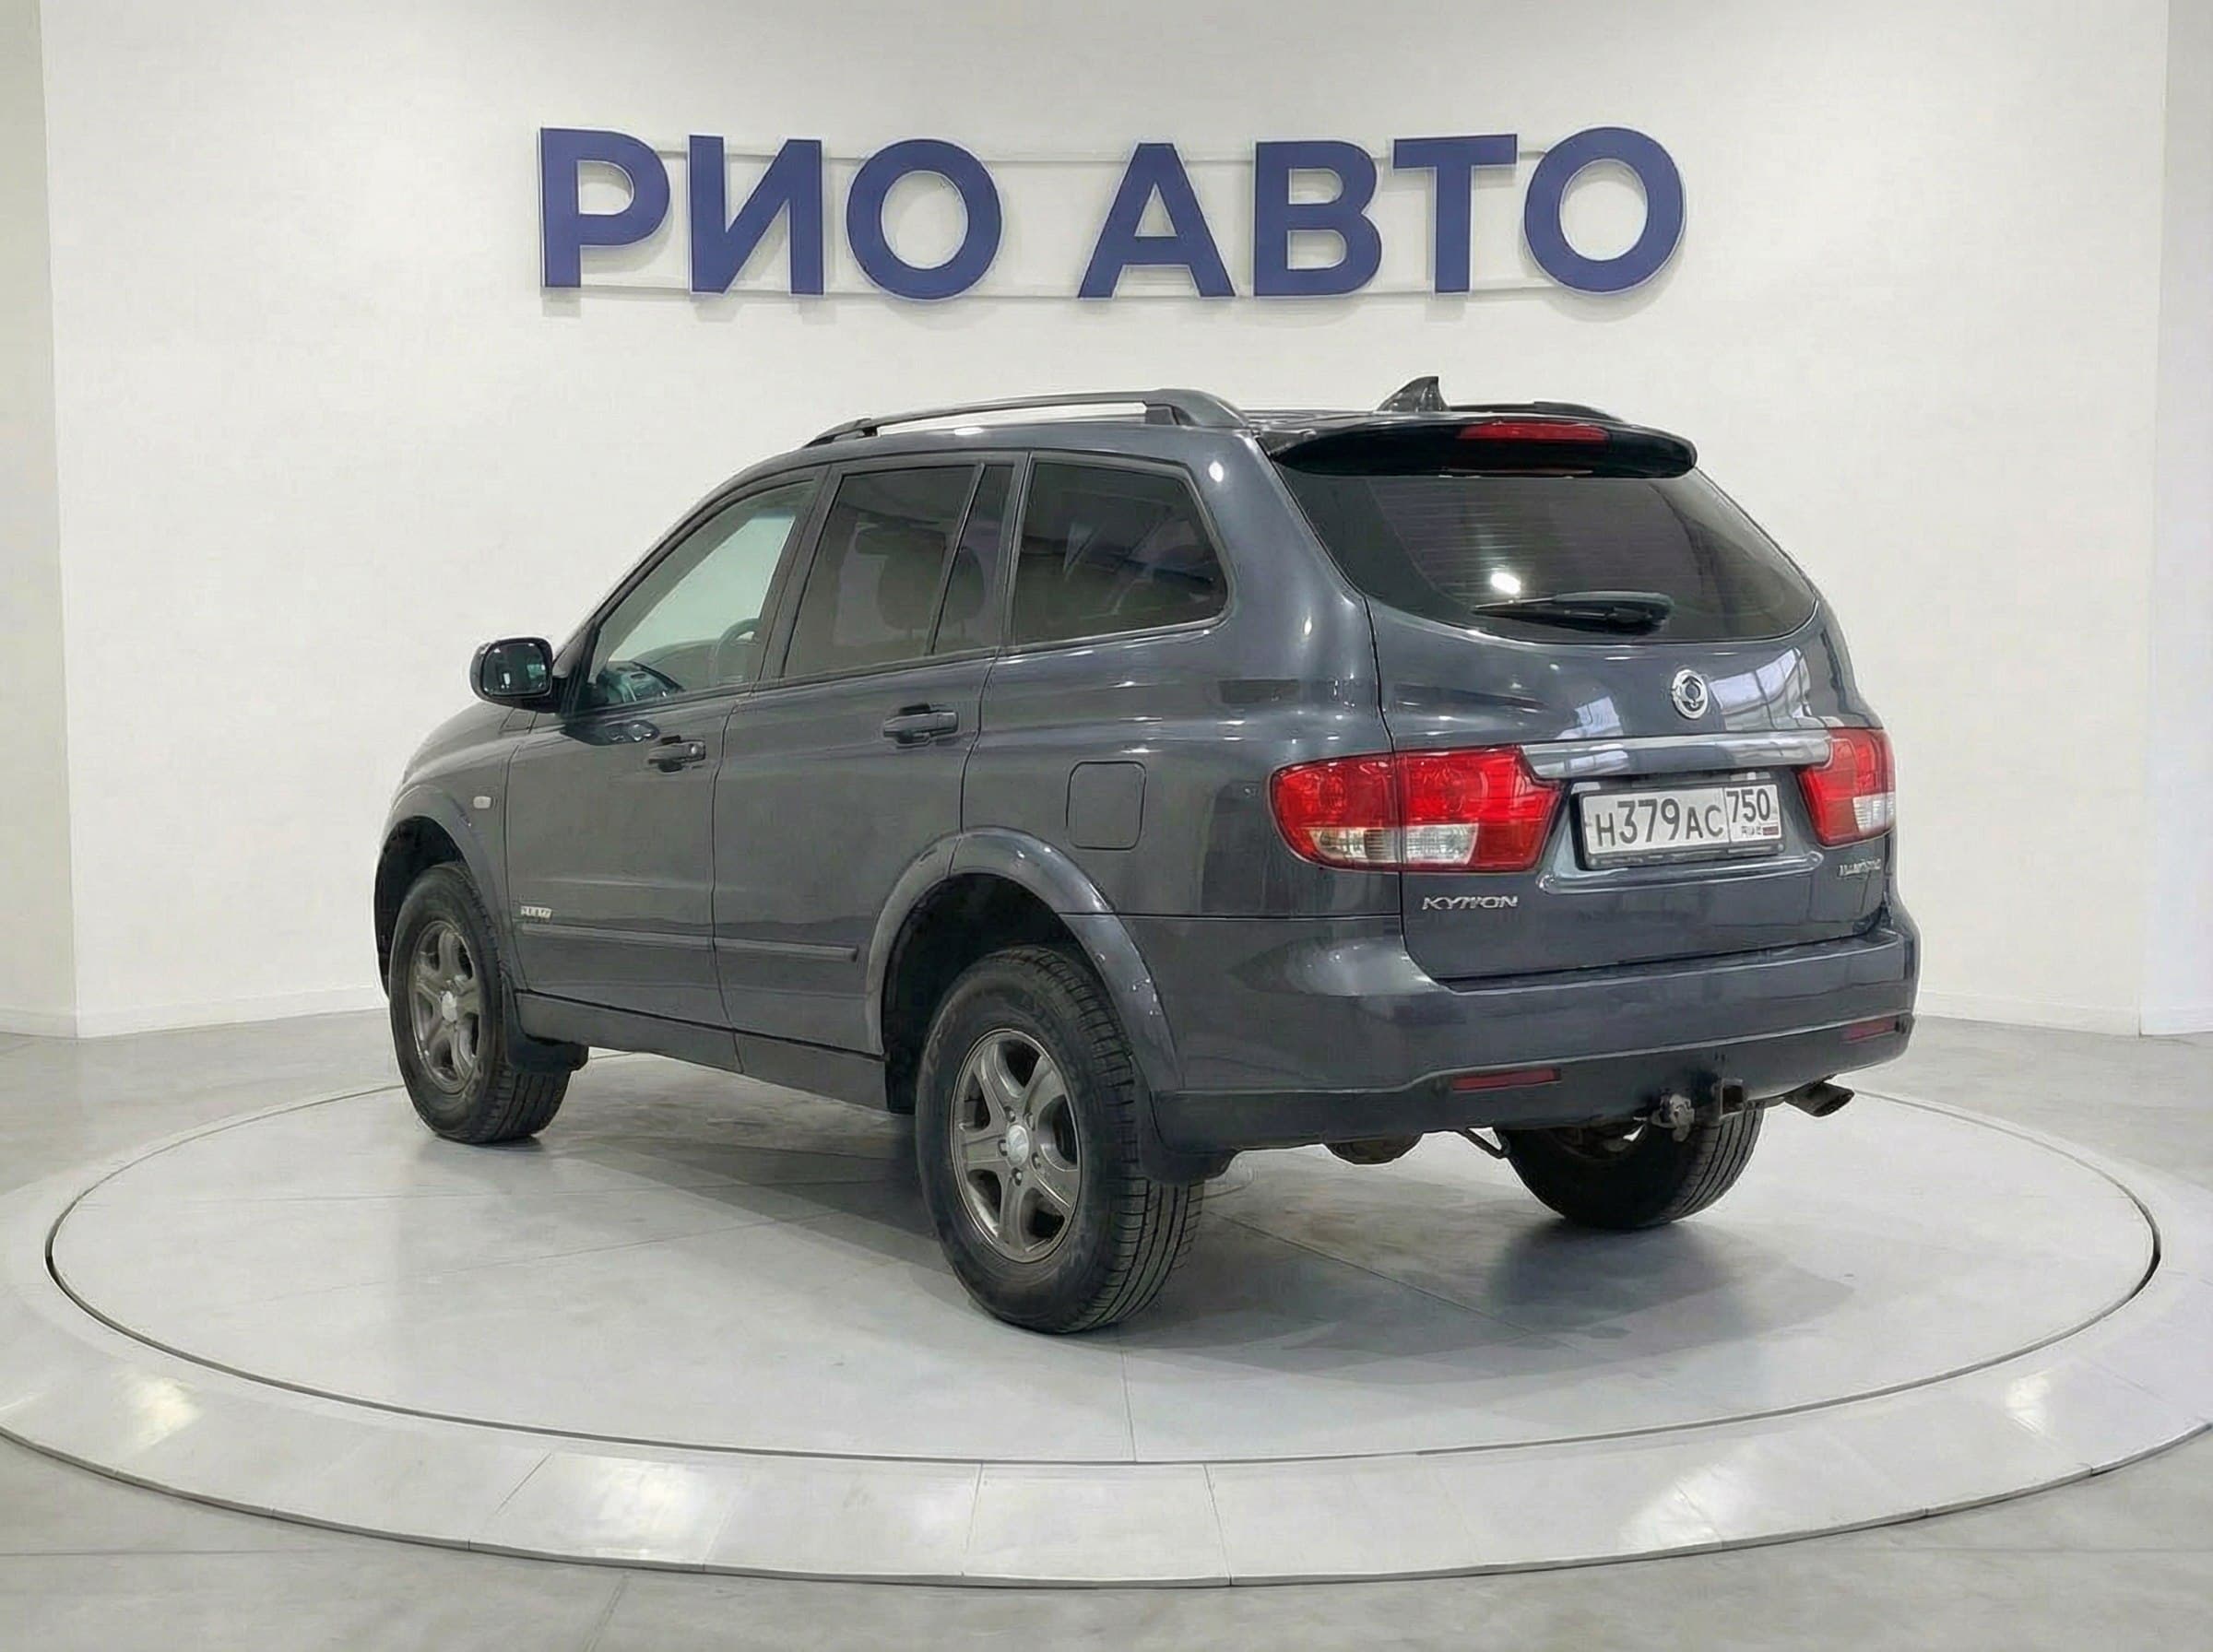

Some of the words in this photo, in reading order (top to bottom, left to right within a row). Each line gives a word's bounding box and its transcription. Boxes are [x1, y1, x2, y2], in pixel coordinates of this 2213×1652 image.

[540, 127, 1001, 301] РИО
[1078, 127, 1685, 299] АВТО
[1726, 788, 1771, 823] 750
